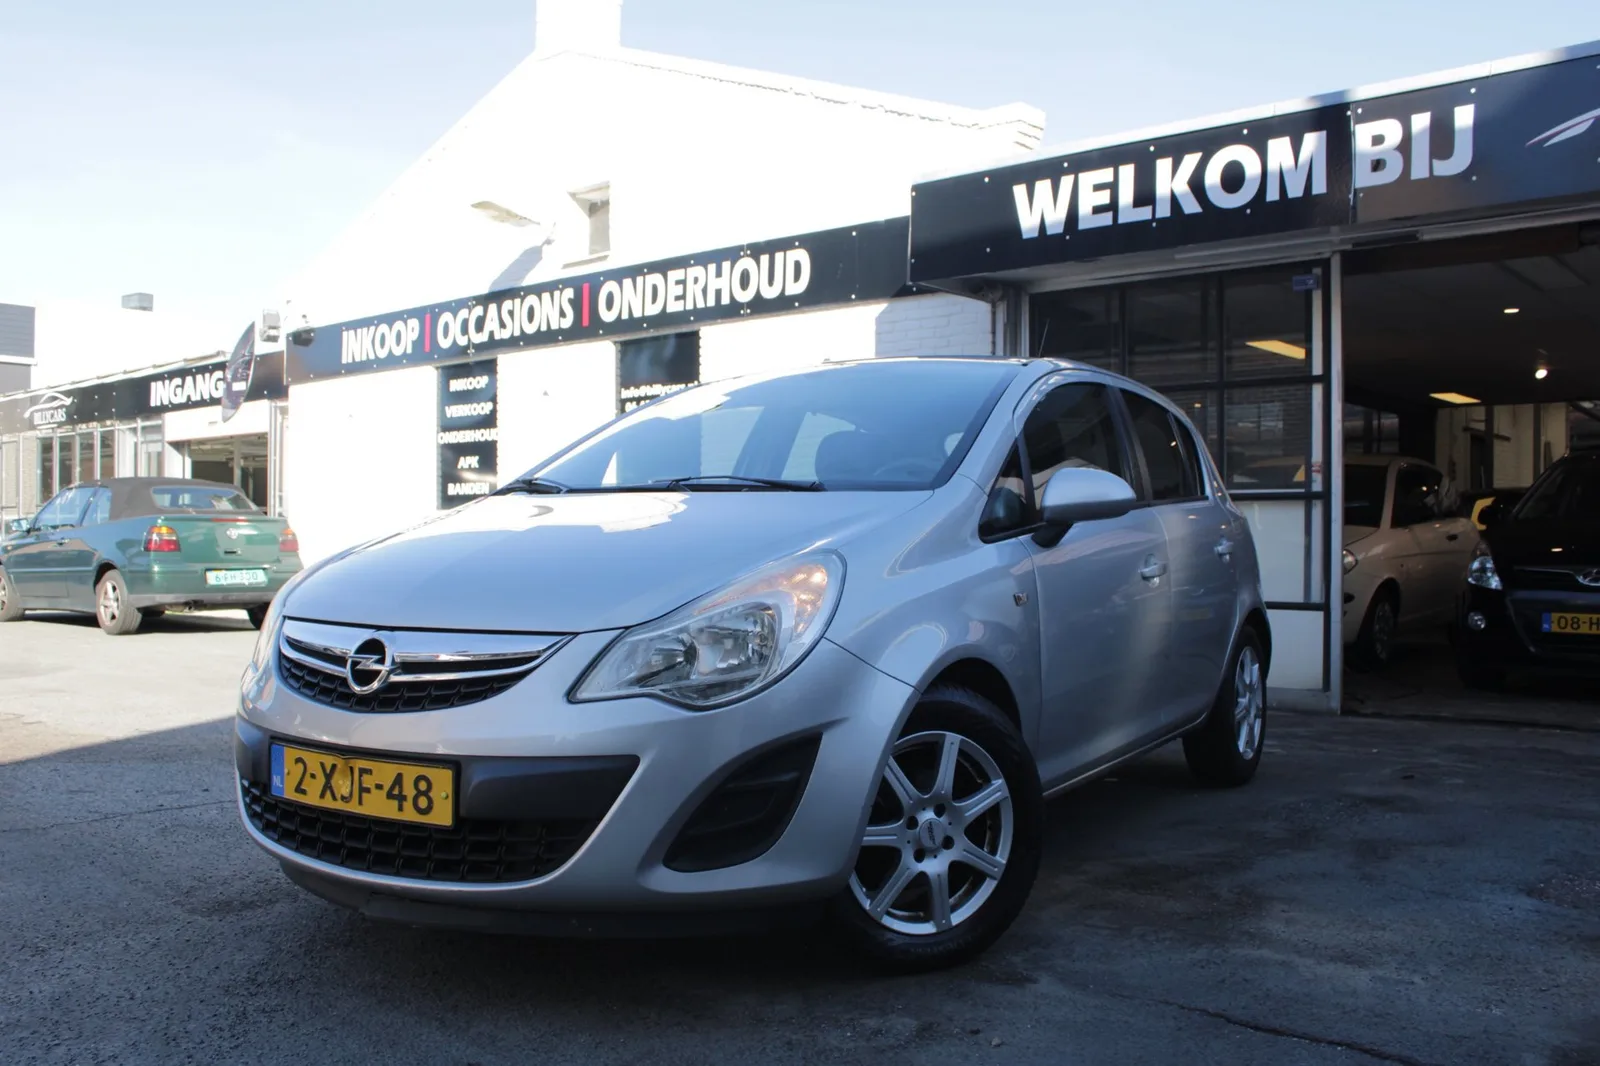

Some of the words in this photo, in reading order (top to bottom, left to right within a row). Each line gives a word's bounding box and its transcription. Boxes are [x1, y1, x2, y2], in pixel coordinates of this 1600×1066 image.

[1012, 130, 1327, 239] WELKOM
[1353, 103, 1475, 188] BIJ
[341, 317, 419, 364] INKOOP
[436, 287, 575, 349] OCCASIONS
[597, 248, 811, 323] ONDERHOUD
[149, 370, 224, 407] INGANG
[449, 376, 489, 392] INKOOP
[445, 402, 494, 418] VERKOOP
[457, 456, 479, 469] APK
[447, 482, 490, 496] BANDEN
[272, 775, 283, 787] NL
[293, 756, 434, 816] 2-XJF-48
